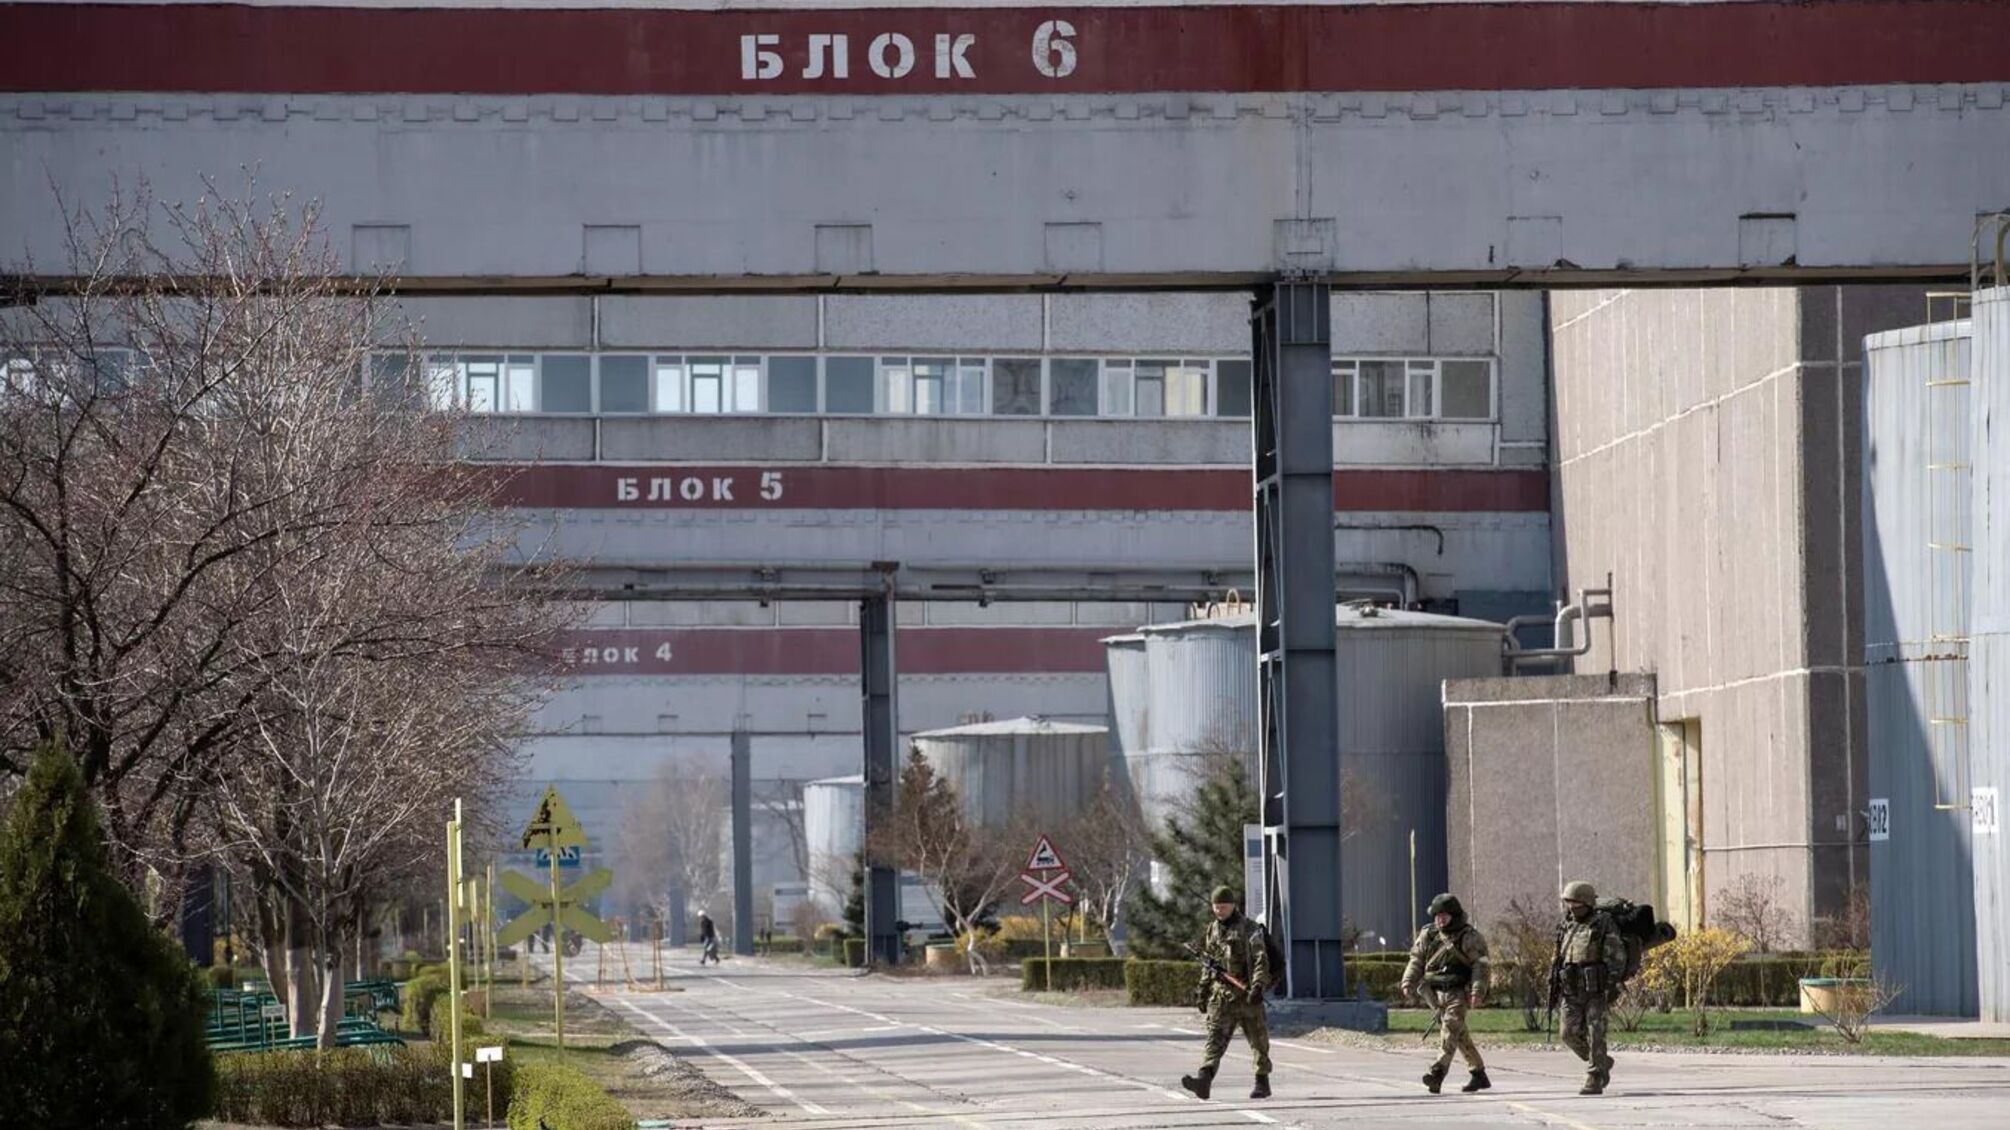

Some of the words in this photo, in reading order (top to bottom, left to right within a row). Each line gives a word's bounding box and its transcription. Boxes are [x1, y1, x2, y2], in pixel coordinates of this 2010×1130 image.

[741, 33, 976, 79] БЛОК
[1032, 20, 1077, 77] 6
[617, 477, 734, 500] БЛОК
[760, 472, 783, 500] 5
[655, 642, 672, 661] 4
